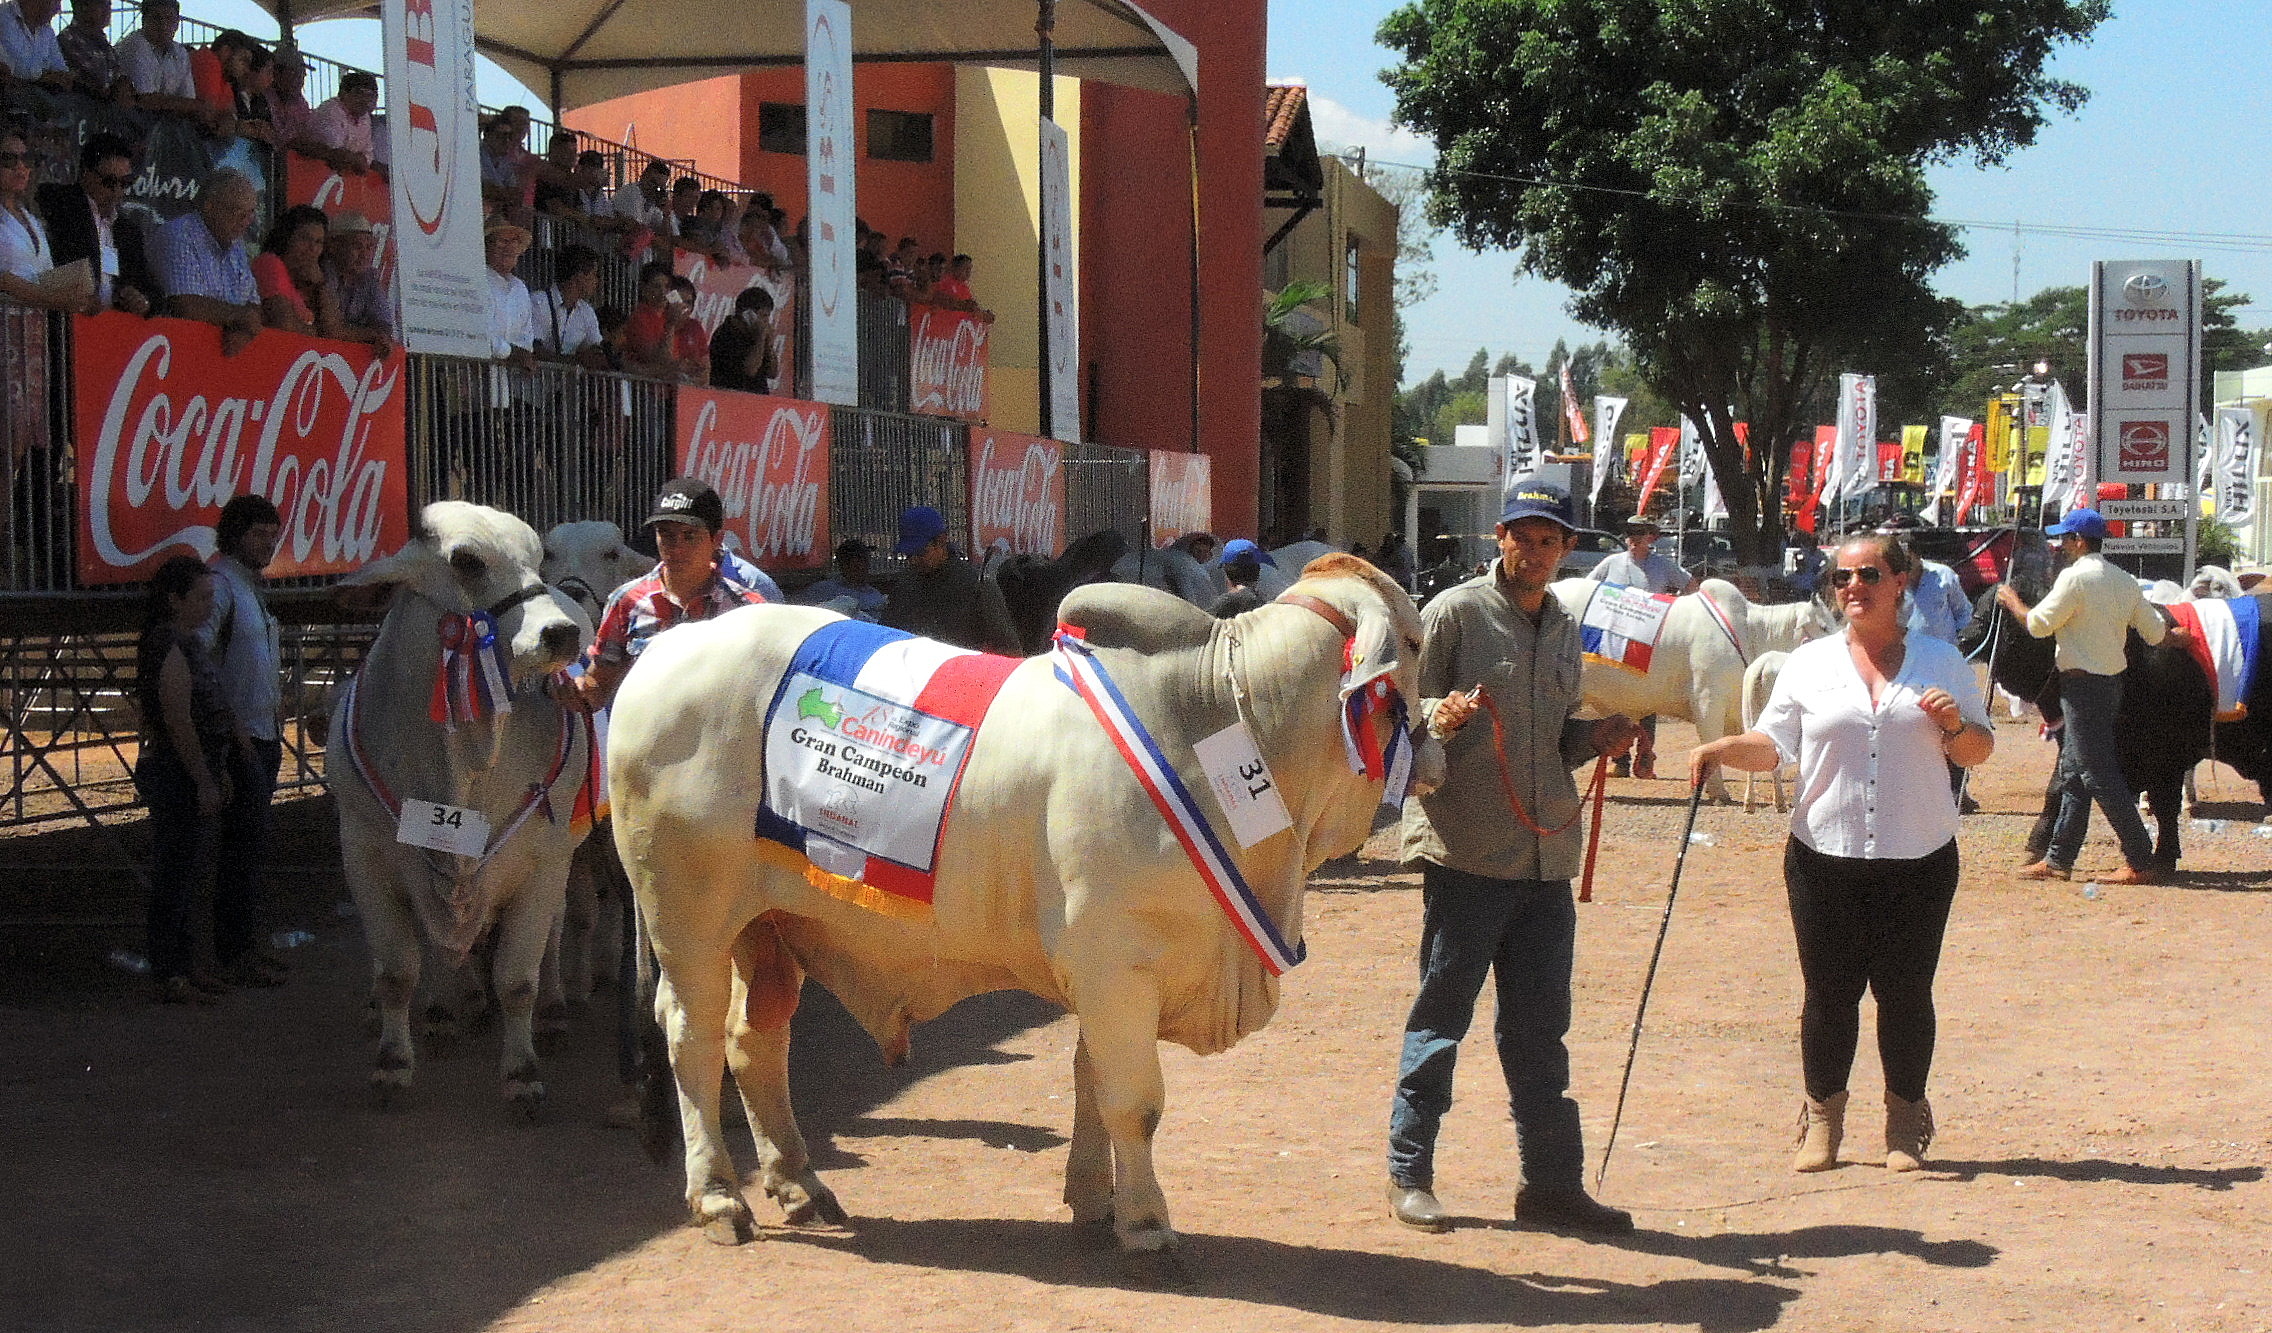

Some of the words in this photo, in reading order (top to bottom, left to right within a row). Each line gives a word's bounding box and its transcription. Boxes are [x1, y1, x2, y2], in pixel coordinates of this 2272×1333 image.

[2114, 309, 2179, 321] TOYOTA
[911, 312, 987, 411] Coca-Cola
[2122, 381, 2168, 391] DAIHATSU
[1514, 383, 1534, 474] HILUX
[1855, 381, 1868, 461] TOYOTA
[90, 334, 398, 567] Coca-Cola
[2122, 459, 2166, 468] HINO
[2231, 418, 2250, 513] HILUX
[791, 727, 837, 757] Gran
[841, 745, 928, 788] Campeón
[841, 716, 947, 766] Canindeyú
[816, 757, 885, 794] Brahman
[1239, 758, 1271, 800] 31
[431, 806, 463, 830] 34
